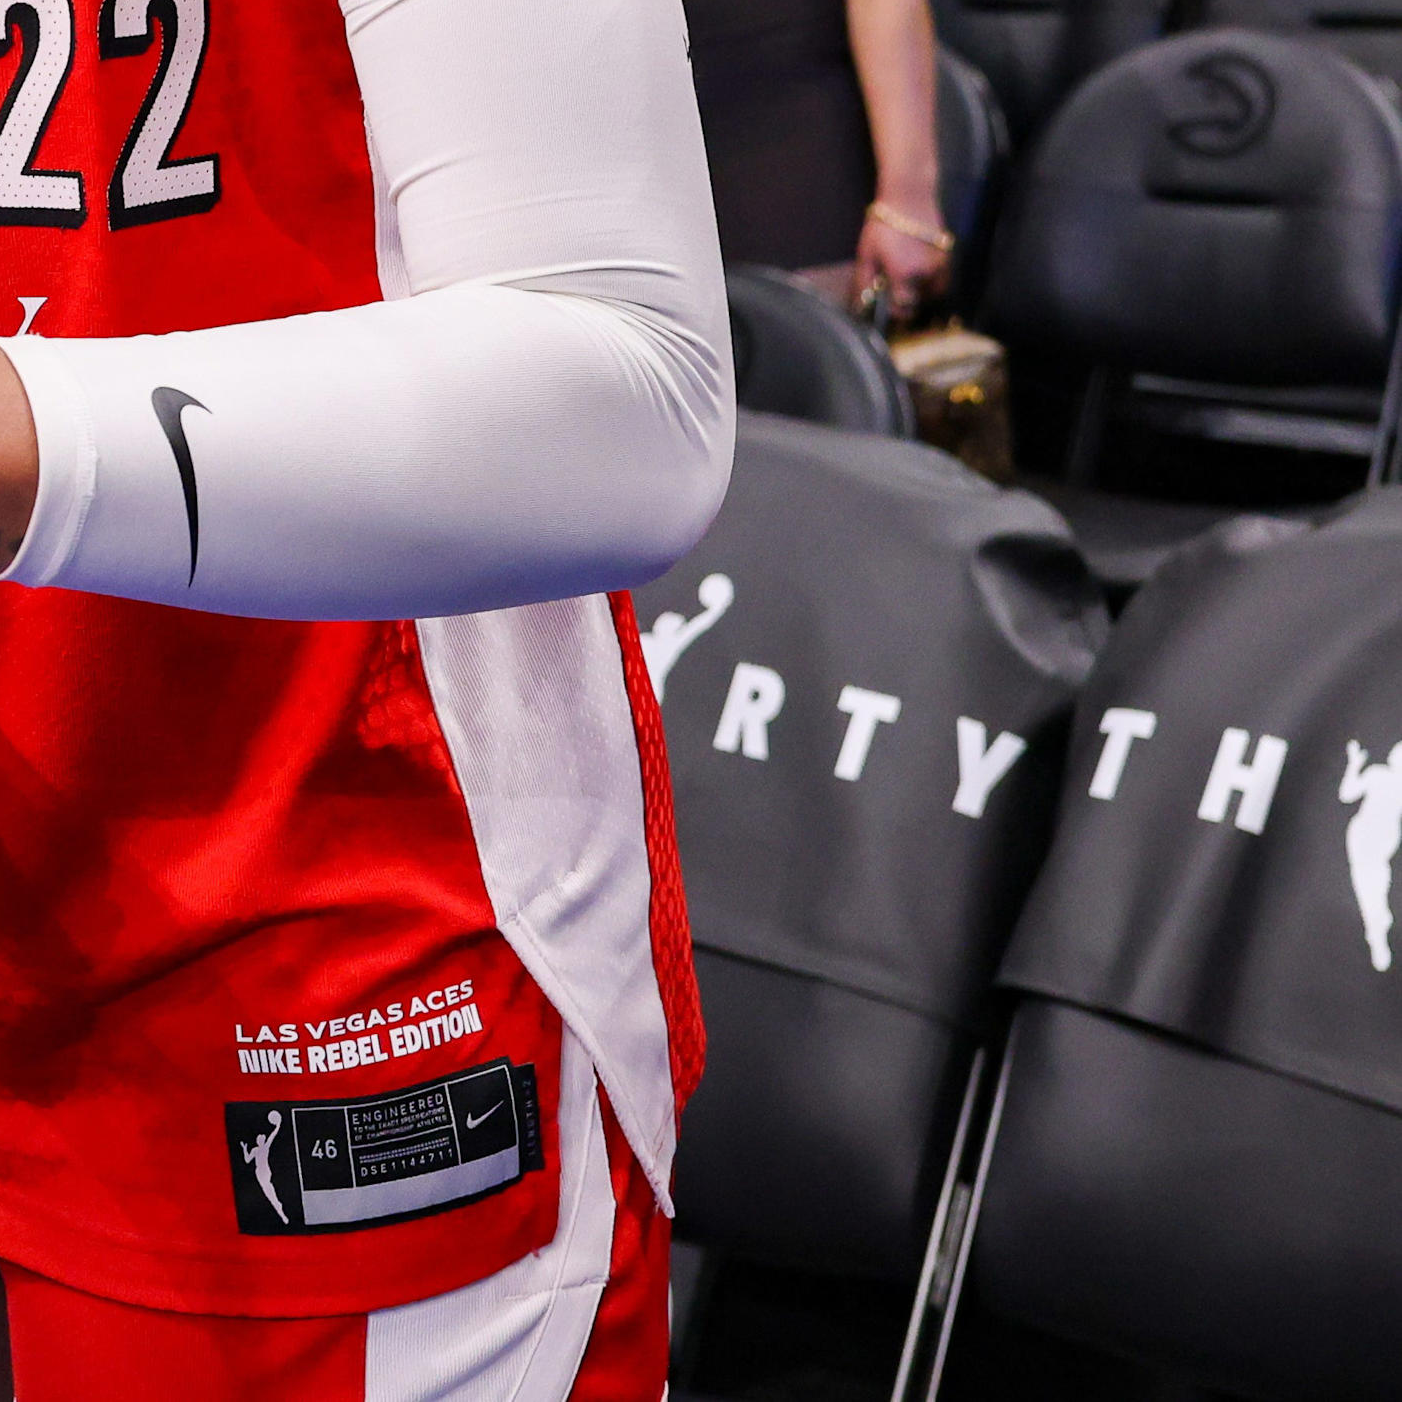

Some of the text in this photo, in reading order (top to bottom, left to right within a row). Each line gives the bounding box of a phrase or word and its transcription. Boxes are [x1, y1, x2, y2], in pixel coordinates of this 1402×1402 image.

[235, 980, 474, 1044] LAS VEGAS ACES
[237, 1003, 483, 1075] NIKE REBEL EDITION
[352, 1093, 444, 1125] ENGINEERED
[311, 1139, 338, 1160] 46
